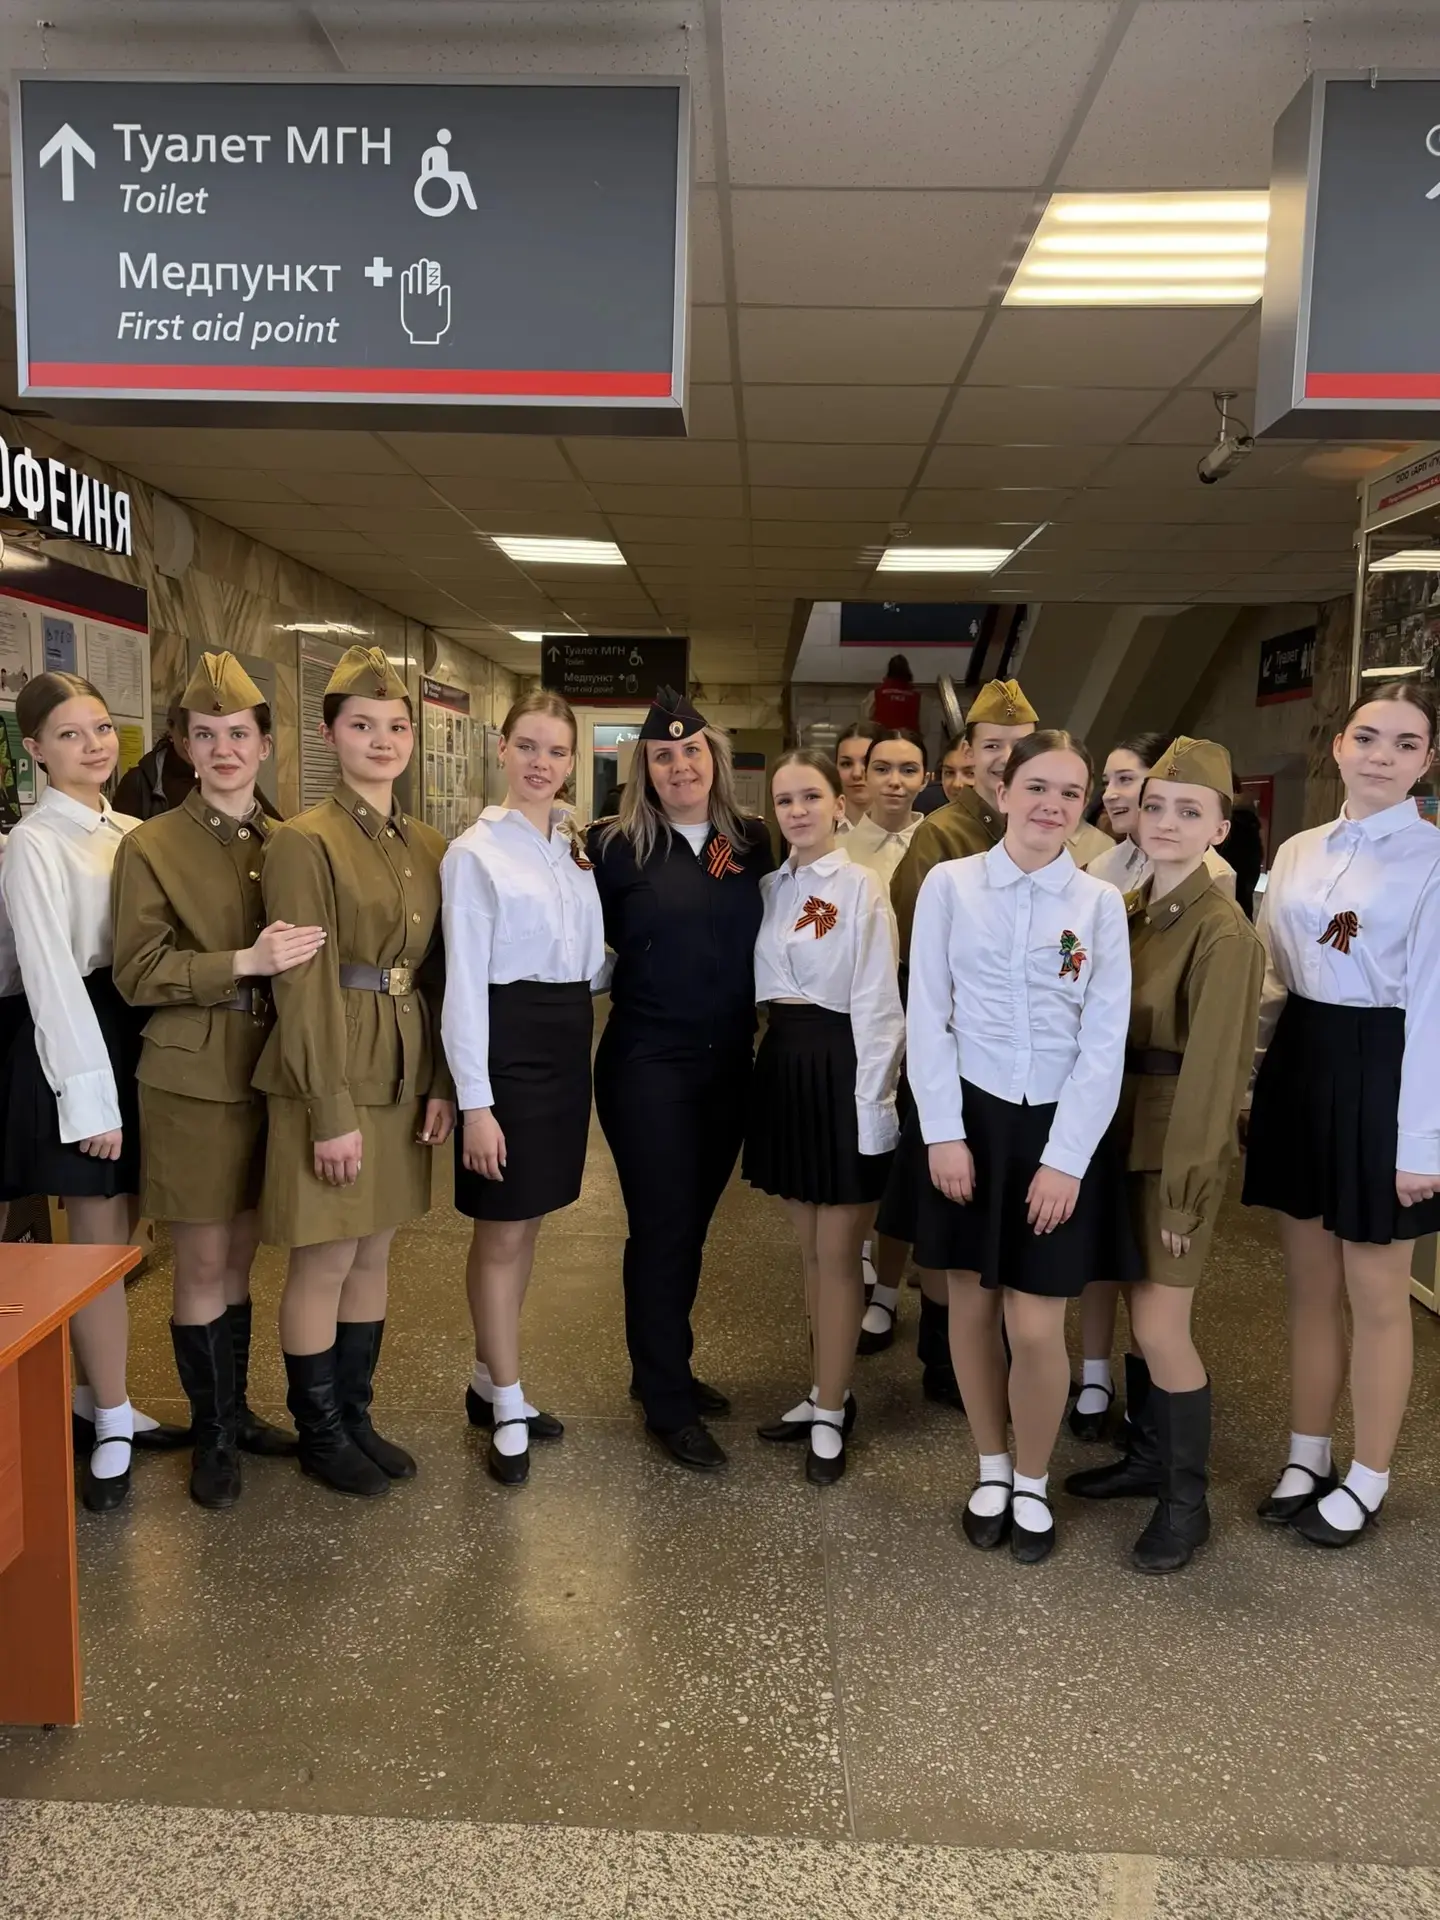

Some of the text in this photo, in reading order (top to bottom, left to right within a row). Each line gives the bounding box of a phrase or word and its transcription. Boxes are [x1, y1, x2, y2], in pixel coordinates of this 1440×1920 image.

[112, 123, 391, 173] Туалет МГН
[119, 182, 209, 215] Toilet
[119, 251, 342, 302] Медпункт
[117, 311, 340, 350] First aid point
[563, 645, 626, 657] Туалет МГН
[563, 672, 614, 684] Медпункт
